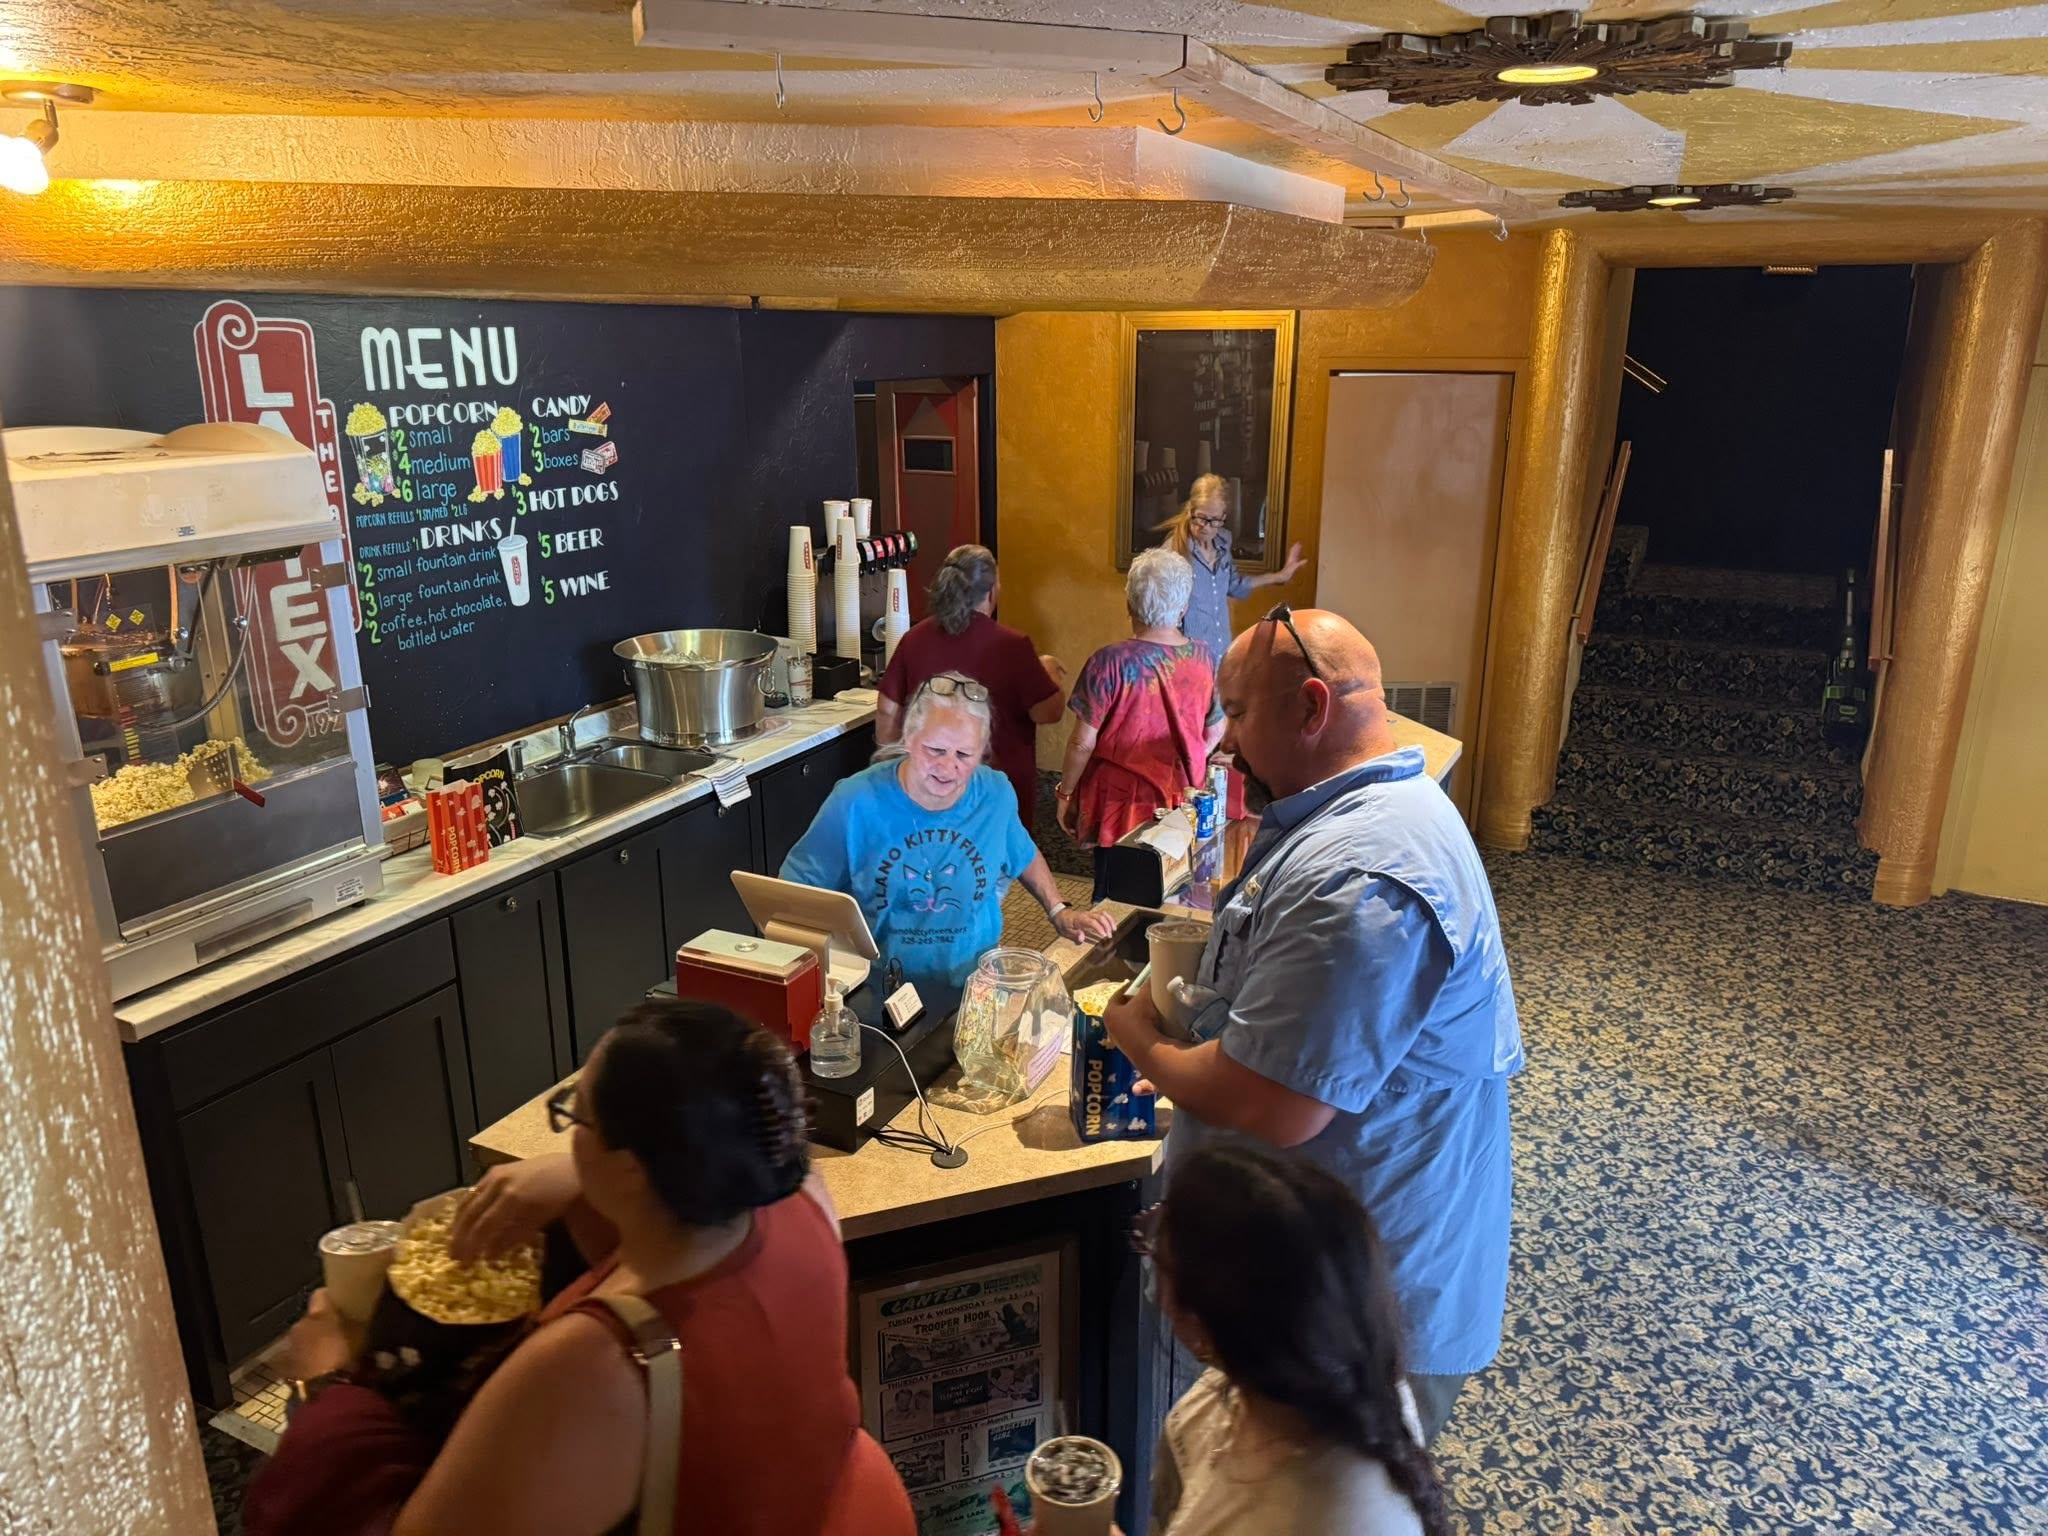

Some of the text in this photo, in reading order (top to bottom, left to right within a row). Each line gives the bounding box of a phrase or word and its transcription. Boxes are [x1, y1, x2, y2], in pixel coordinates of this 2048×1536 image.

[361, 326, 518, 391] MENU
[388, 400, 498, 428] POPCORN
[532, 395, 591, 418] CANDY
[390, 425, 452, 452] $2 small
[529, 423, 541, 448] $2
[541, 426, 571, 444] bars
[411, 451, 471, 475] medium
[531, 449, 544, 473] $3
[544, 452, 578, 468] boxes
[416, 479, 457, 506] large
[529, 487, 566, 512] HOT
[571, 480, 619, 507] DOGS
[355, 513, 387, 529] POPCORN
[387, 511, 415, 525] REFILLS
[420, 517, 502, 550] DRINKS
[359, 544, 382, 559] DRINK
[555, 528, 604, 554] BEER
[377, 559, 412, 582] small
[416, 553, 466, 573] fountain
[468, 546, 497, 564] drink
[378, 591, 413, 612] large
[418, 578, 471, 599] fountain
[473, 569, 501, 588] drink
[560, 570, 611, 598] WINE
[381, 615, 427, 634] coffee,
[428, 608, 448, 624] hot
[451, 594, 507, 618] chocolate,
[397, 621, 475, 651] bottled water
[472, 769, 505, 784] OPCORN
[448, 826, 462, 873] POPCORN
[875, 847, 901, 910] LLANO
[1086, 1059, 1103, 1136] POPCORN
[913, 1316, 960, 1335] TROOPER
[963, 1310, 991, 1323] HOOK
[960, 1432, 970, 1478] PLUS
